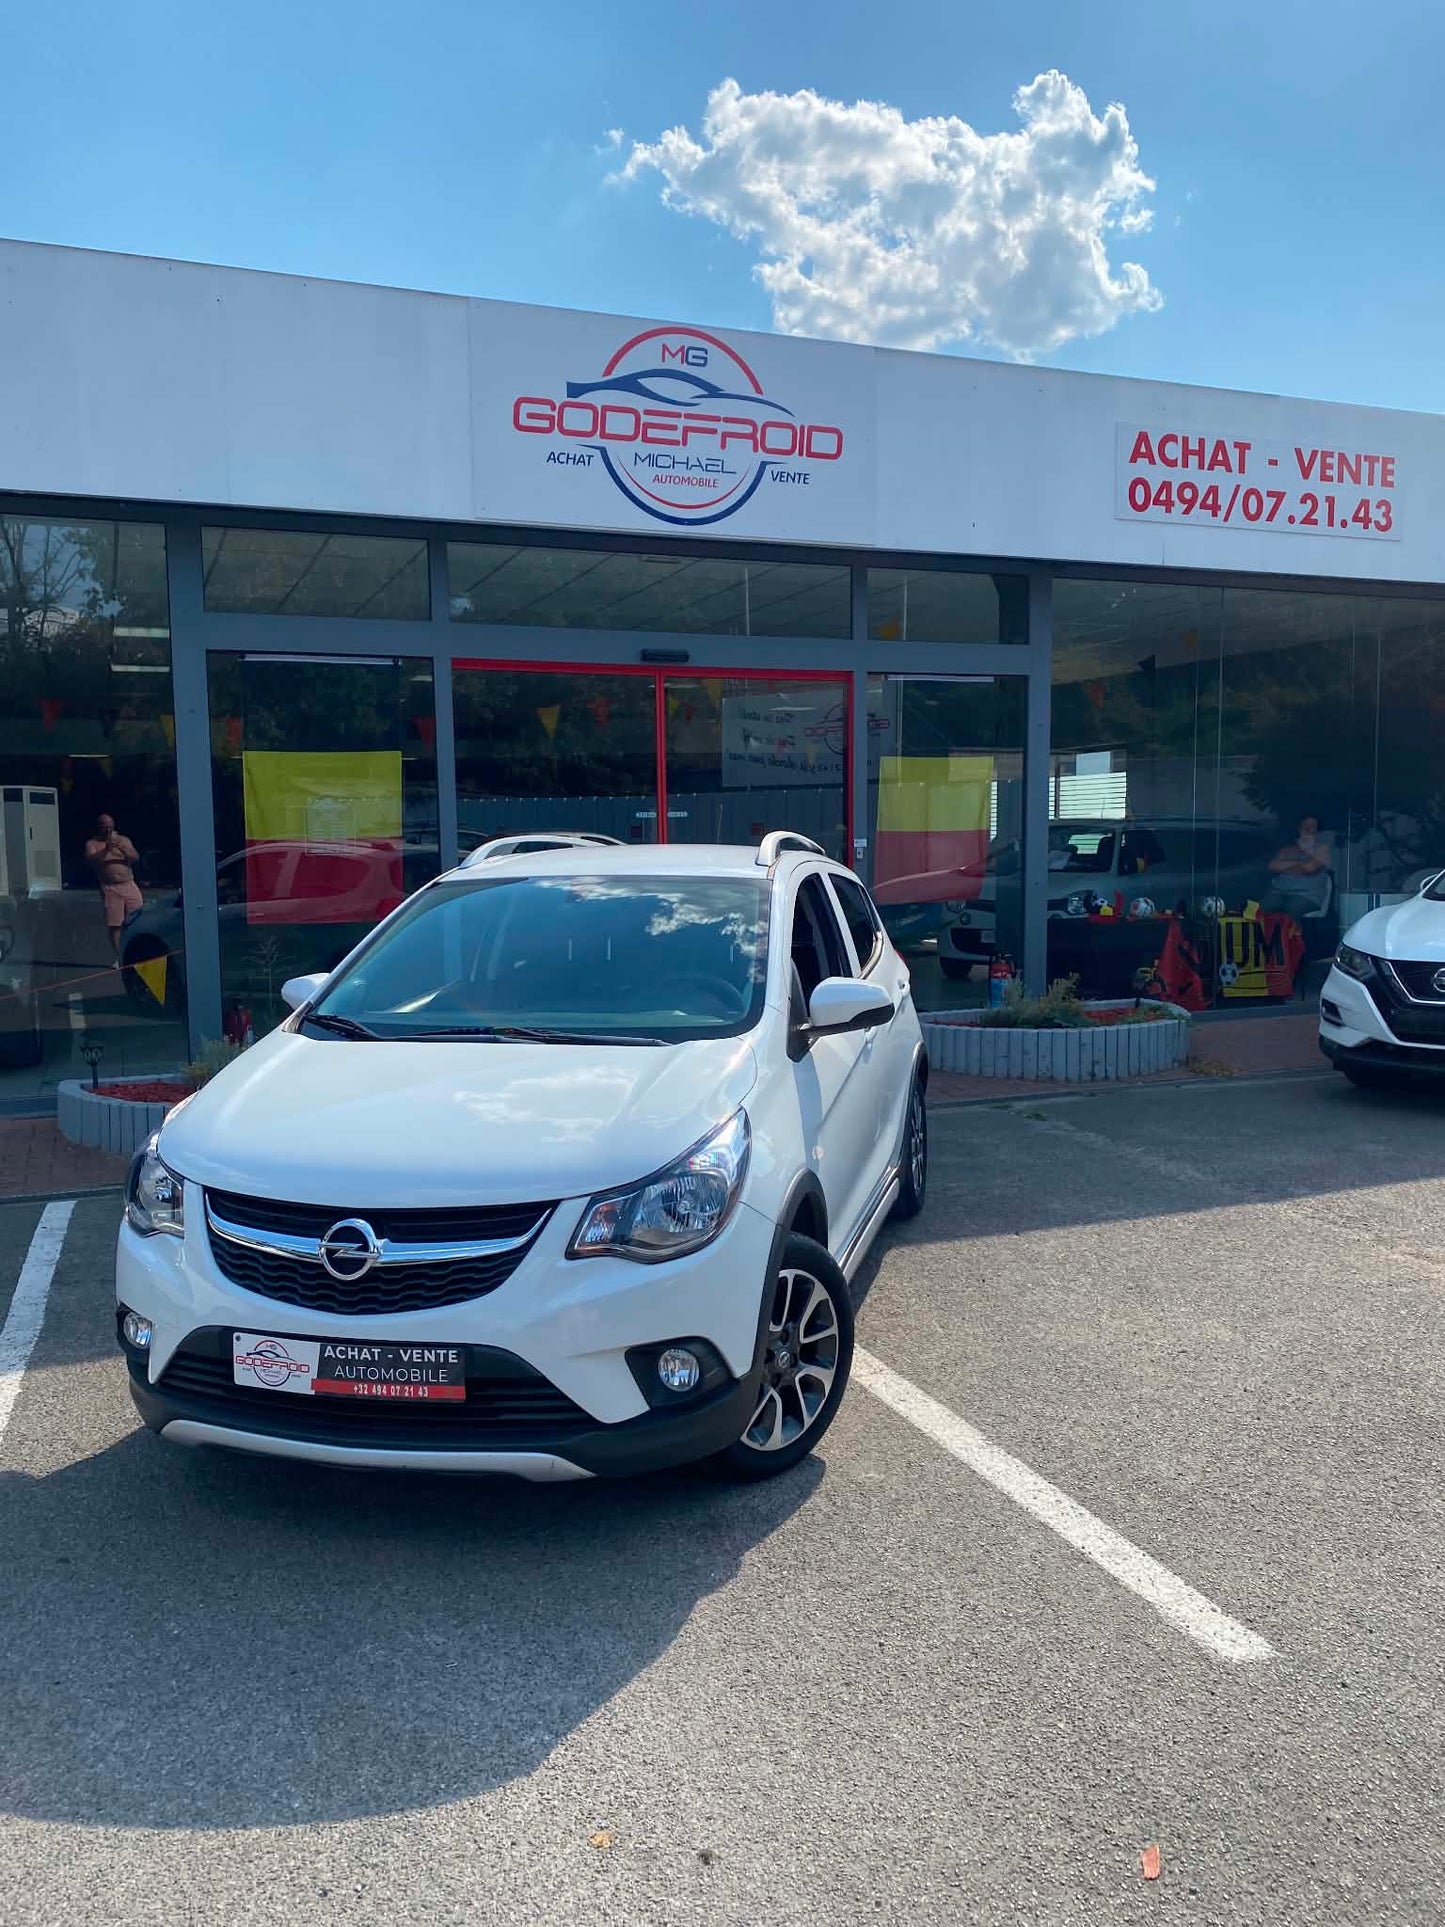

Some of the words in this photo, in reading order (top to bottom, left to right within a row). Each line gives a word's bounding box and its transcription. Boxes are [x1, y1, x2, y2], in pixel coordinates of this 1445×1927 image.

[661, 343, 708, 367] MG
[512, 396, 843, 461] GODEFROID
[546, 451, 594, 467] ACHAT
[634, 452, 737, 475] MICHAEL
[1128, 431, 1251, 475] ACHAT
[1267, 458, 1279, 467] -
[1294, 447, 1396, 489] VENTE
[652, 473, 719, 489] AUTOMOBILE
[771, 470, 810, 485] VENTE
[1128, 477, 1393, 532] 0494/07.21.43
[324, 1345, 382, 1361] ACHAT
[400, 1349, 459, 1364] VENTE
[235, 1355, 310, 1374] GODEFROID
[334, 1365, 449, 1383] AUTOMOBILE
[353, 1383, 368, 1395] +32
[372, 1384, 388, 1396] 494
[390, 1385, 401, 1397] 07
[403, 1386, 415, 1397] 21
[418, 1386, 429, 1397] 43
